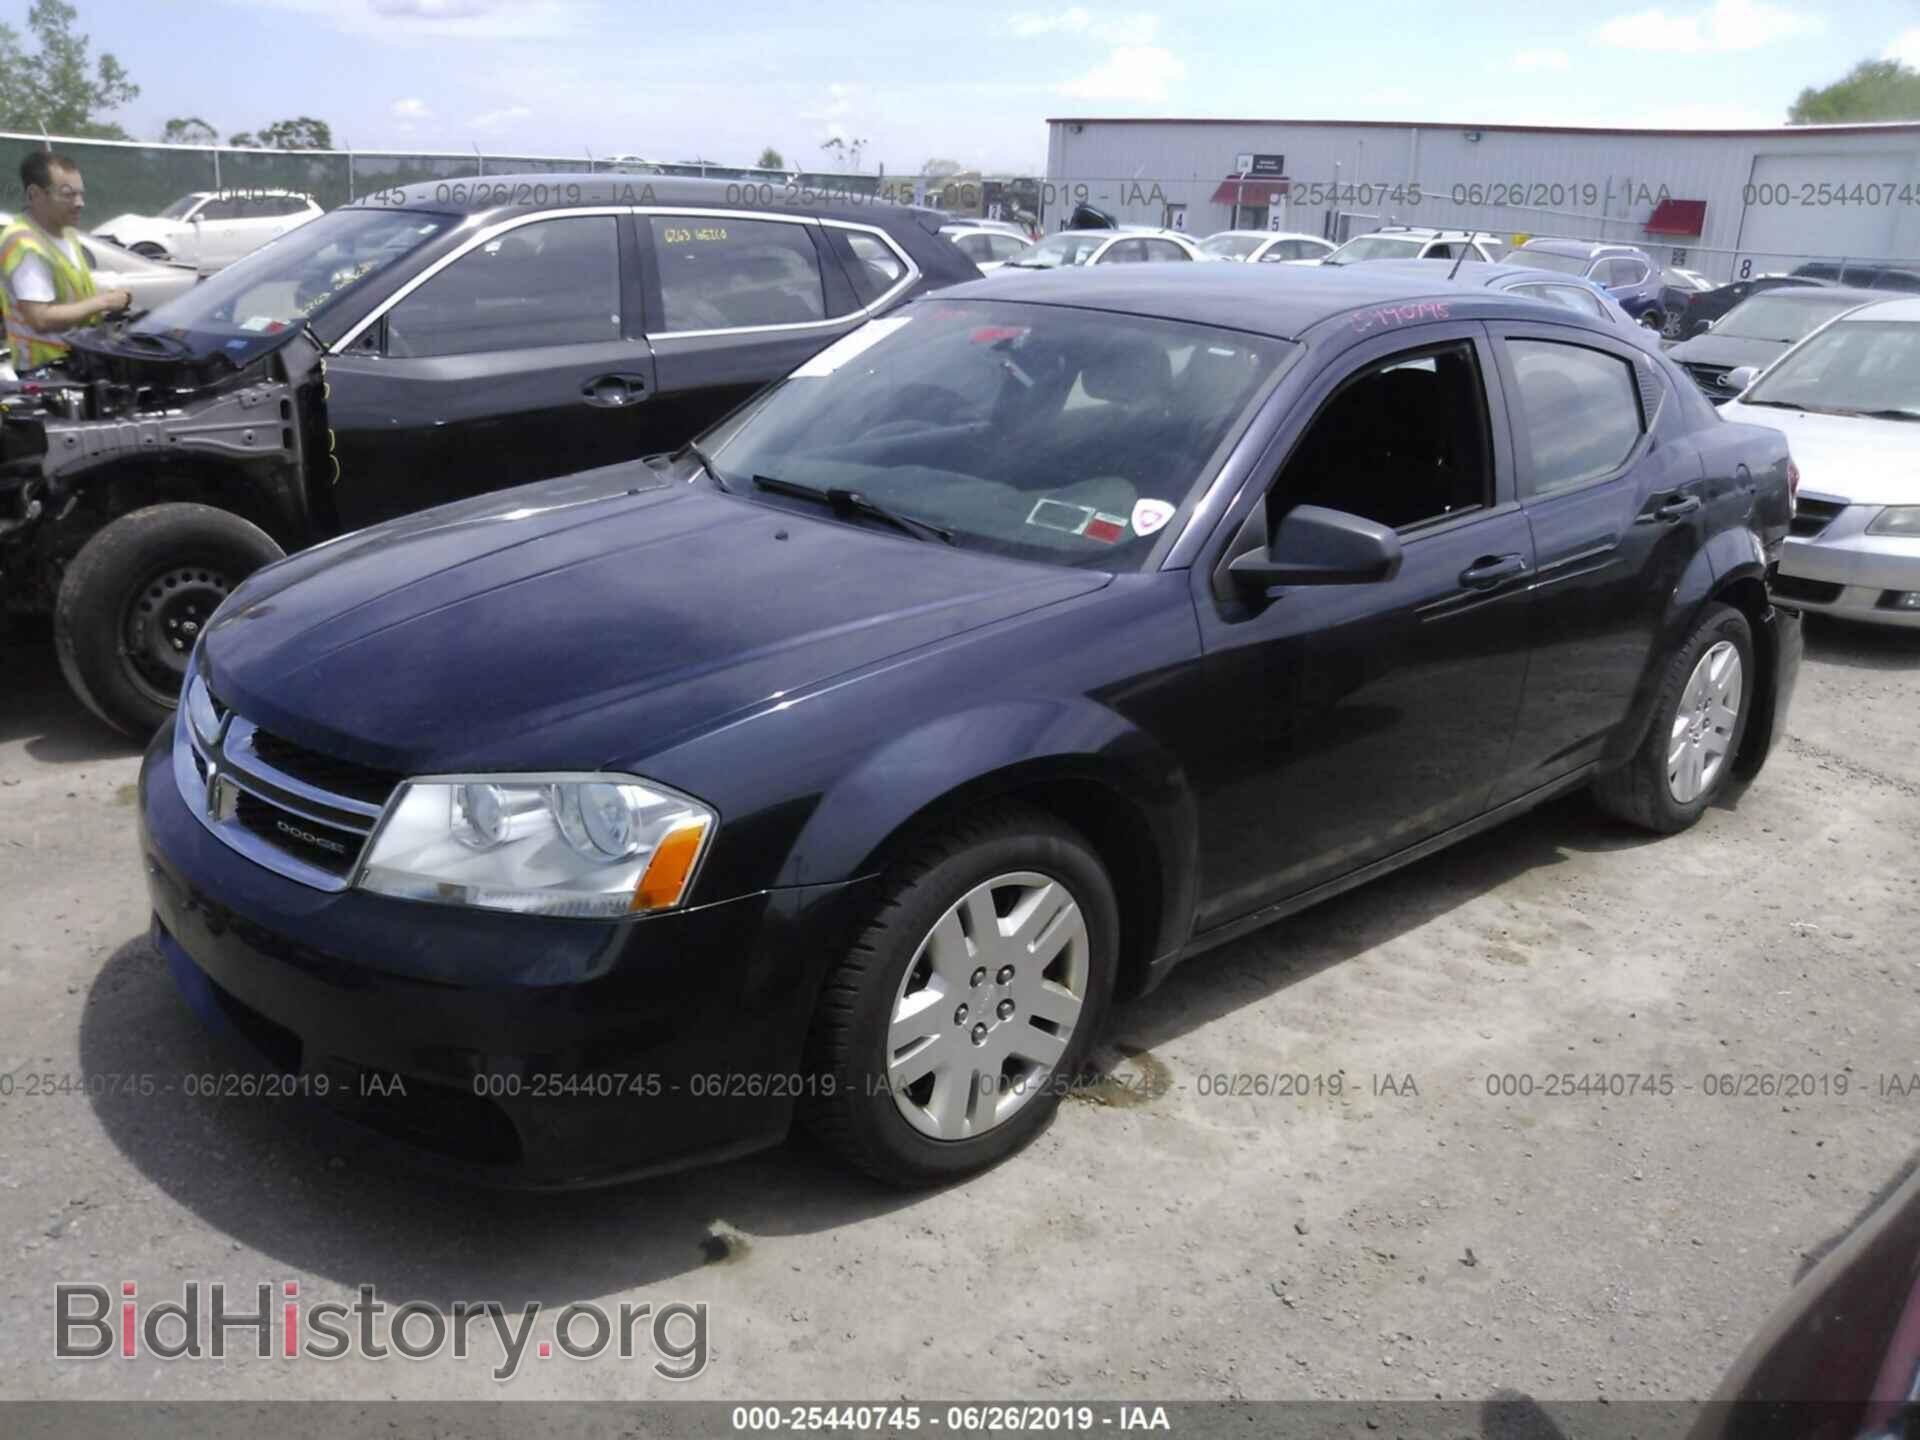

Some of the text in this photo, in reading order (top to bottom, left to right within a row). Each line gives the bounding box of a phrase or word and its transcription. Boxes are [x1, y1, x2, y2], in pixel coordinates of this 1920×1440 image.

[1176, 213, 1184, 227] 4
[1271, 216, 1280, 232] 5
[1740, 259, 1752, 279] 8
[276, 820, 345, 853] DODGE
